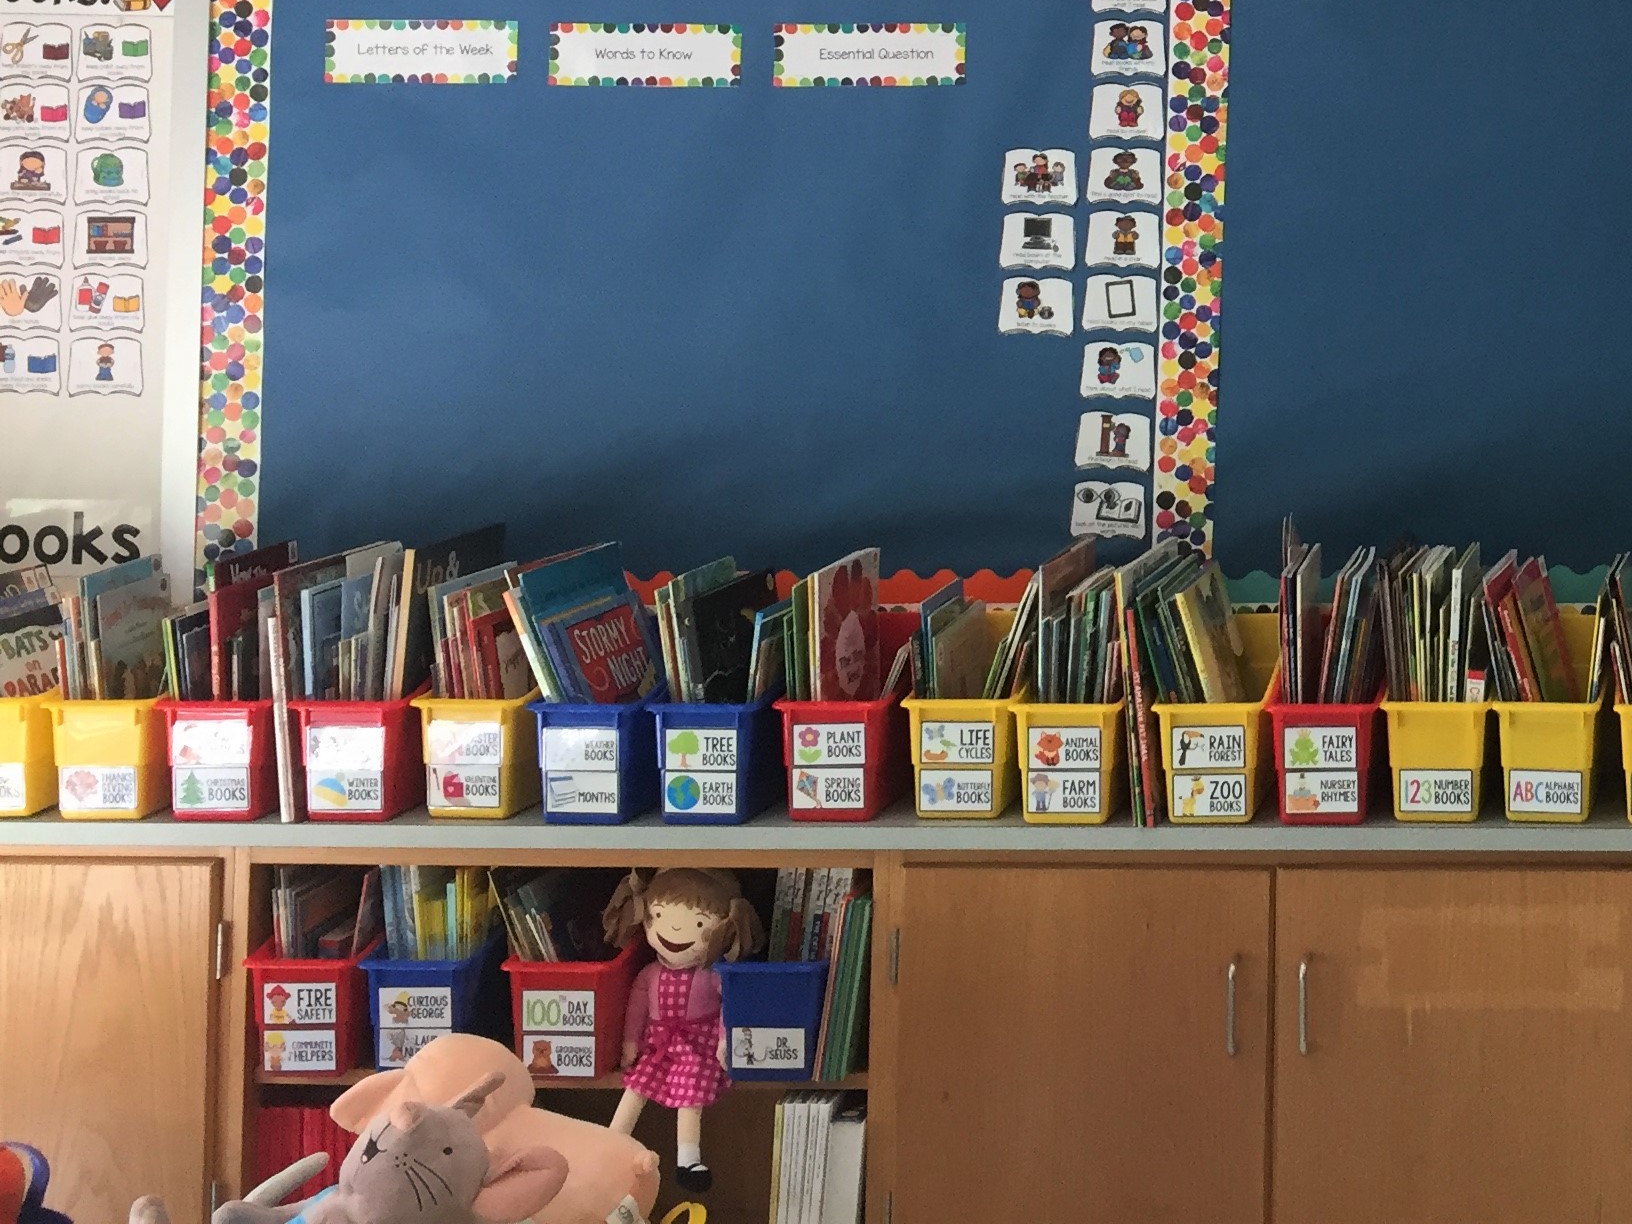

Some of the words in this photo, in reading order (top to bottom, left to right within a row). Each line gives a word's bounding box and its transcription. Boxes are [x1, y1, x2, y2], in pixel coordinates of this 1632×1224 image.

[357, 43, 410, 56] Letters
[413, 43, 429, 56] of
[434, 43, 455, 56] the
[459, 43, 494, 56] Week
[595, 48, 636, 60] Words
[640, 48, 656, 60] to
[659, 48, 693, 60] Know
[819, 48, 875, 60] Essential
[879, 47, 934, 60] Question
[0, 511, 141, 565] ooks
[574, 618, 631, 663] STORMY
[607, 648, 652, 689] NIGHT
[470, 733, 498, 743] STER
[827, 731, 861, 744] PLANT
[960, 730, 990, 746] LIFE
[1065, 737, 1098, 748] ANIMAL
[1209, 735, 1241, 750] RAIN
[1322, 736, 1353, 748] FAIRY
[465, 744, 498, 756] BOOKS
[584, 740, 614, 749] WEATHER
[703, 737, 734, 752] TREE
[584, 749, 615, 761] BOOKS
[827, 745, 861, 758] BOOKS
[959, 747, 991, 759] CYCLES
[1065, 749, 1098, 761] BOOKS
[1209, 750, 1241, 762] FOREST
[1324, 751, 1352, 763] TALES
[702, 754, 736, 766] BOOKS
[101, 773, 134, 781] THANKS
[347, 777, 378, 787] WINTER
[824, 777, 861, 789] SPRING
[101, 783, 133, 792] GIVING
[465, 784, 497, 796] BOOKS
[702, 783, 733, 794] EARTH
[1063, 780, 1096, 795] FARM
[1209, 781, 1242, 800] ZOO
[1320, 780, 1356, 790] NURSERY
[208, 788, 245, 801] BOOKS
[348, 788, 378, 800] BOOKS
[578, 792, 615, 803] MONTHS
[825, 789, 861, 802] BOOKS
[956, 791, 991, 804] BOOKS
[1321, 791, 1357, 802] RHYMES
[1405, 779, 1433, 804] 123
[1434, 780, 1470, 792] NUMBER
[1512, 781, 1544, 802] ABC
[1545, 782, 1579, 791] ALPHABET
[102, 793, 133, 803] BOOKS
[702, 795, 733, 806] BOOKS
[1063, 796, 1096, 808] BOOKS
[1434, 792, 1470, 804] BOOKS
[1545, 792, 1579, 804] BOOKS
[1210, 800, 1241, 812] BOOKS
[297, 988, 332, 1006] FIRE
[407, 996, 448, 1007] CURIOUS
[410, 1007, 445, 1019] GEORGE
[527, 999, 561, 1026] 100
[568, 1001, 588, 1014] DAY
[297, 1008, 333, 1020] SAFETY
[562, 1014, 593, 1026] BOOKS
[292, 1040, 333, 1050] COMMUNITY
[776, 1036, 790, 1047] DR.
[294, 1050, 334, 1061] HELPERS
[768, 1048, 798, 1060] SEUSS
[557, 1054, 592, 1067] BOOKS
